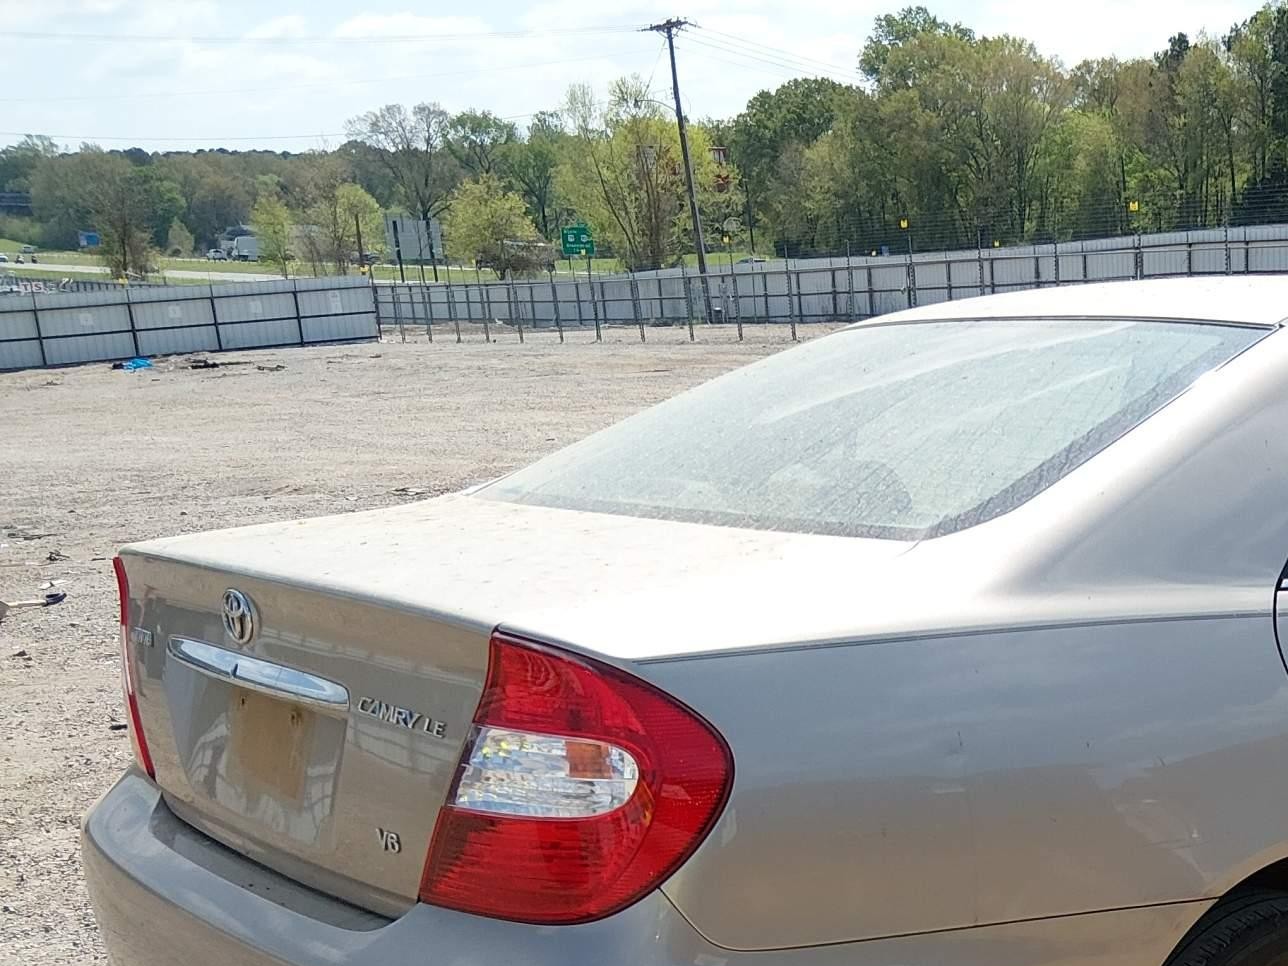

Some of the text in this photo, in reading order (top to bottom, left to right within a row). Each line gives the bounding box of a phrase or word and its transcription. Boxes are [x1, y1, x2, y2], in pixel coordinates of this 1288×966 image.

[358, 696, 447, 739] CAMRY LE
[376, 827, 401, 853] V6
